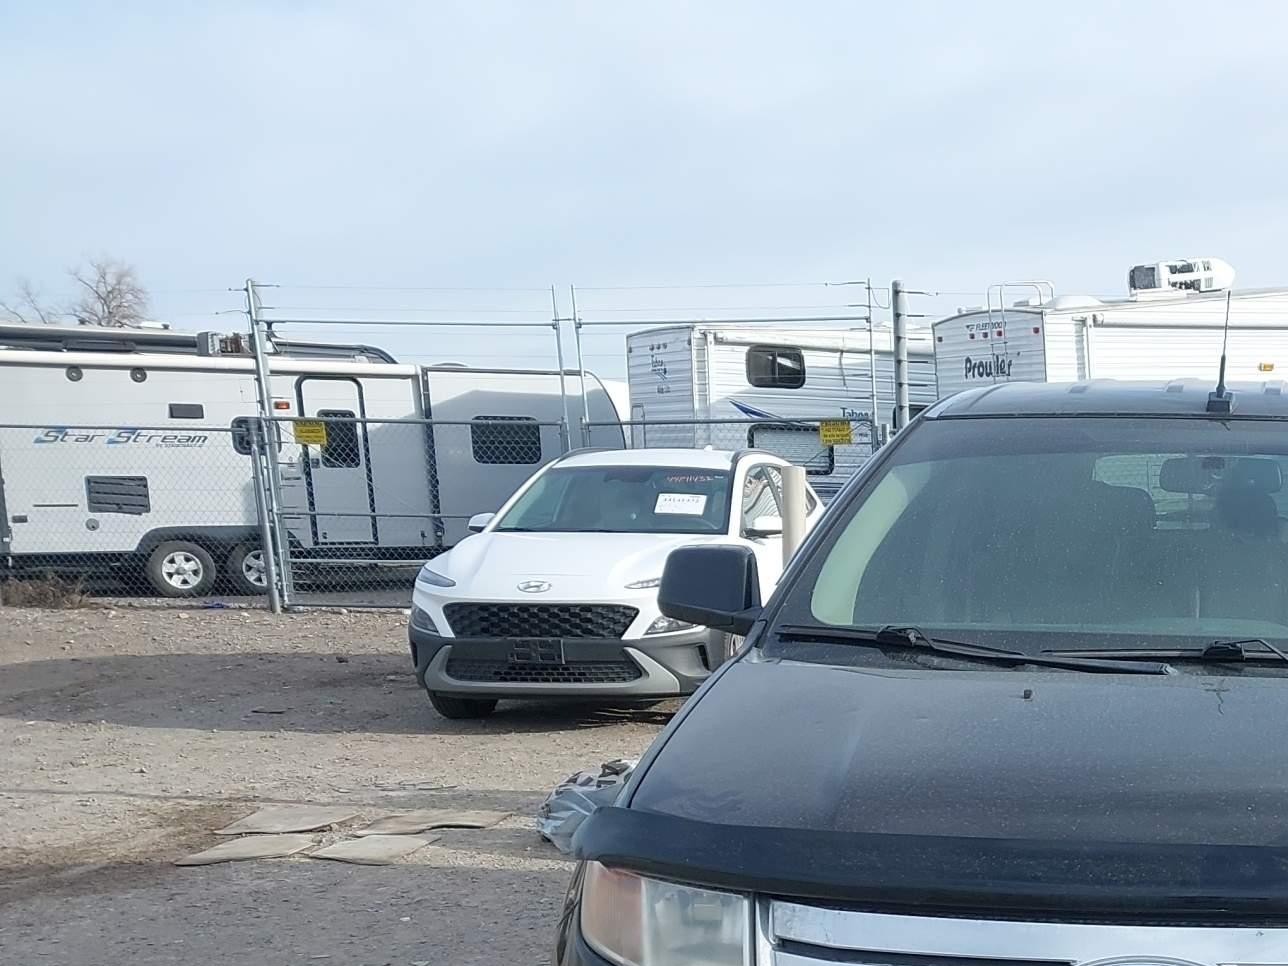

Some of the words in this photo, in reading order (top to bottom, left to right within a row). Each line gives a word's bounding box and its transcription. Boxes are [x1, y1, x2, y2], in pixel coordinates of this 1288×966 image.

[965, 355, 1012, 379] Prowler
[34, 427, 105, 444] Star
[106, 428, 208, 445] Stream
